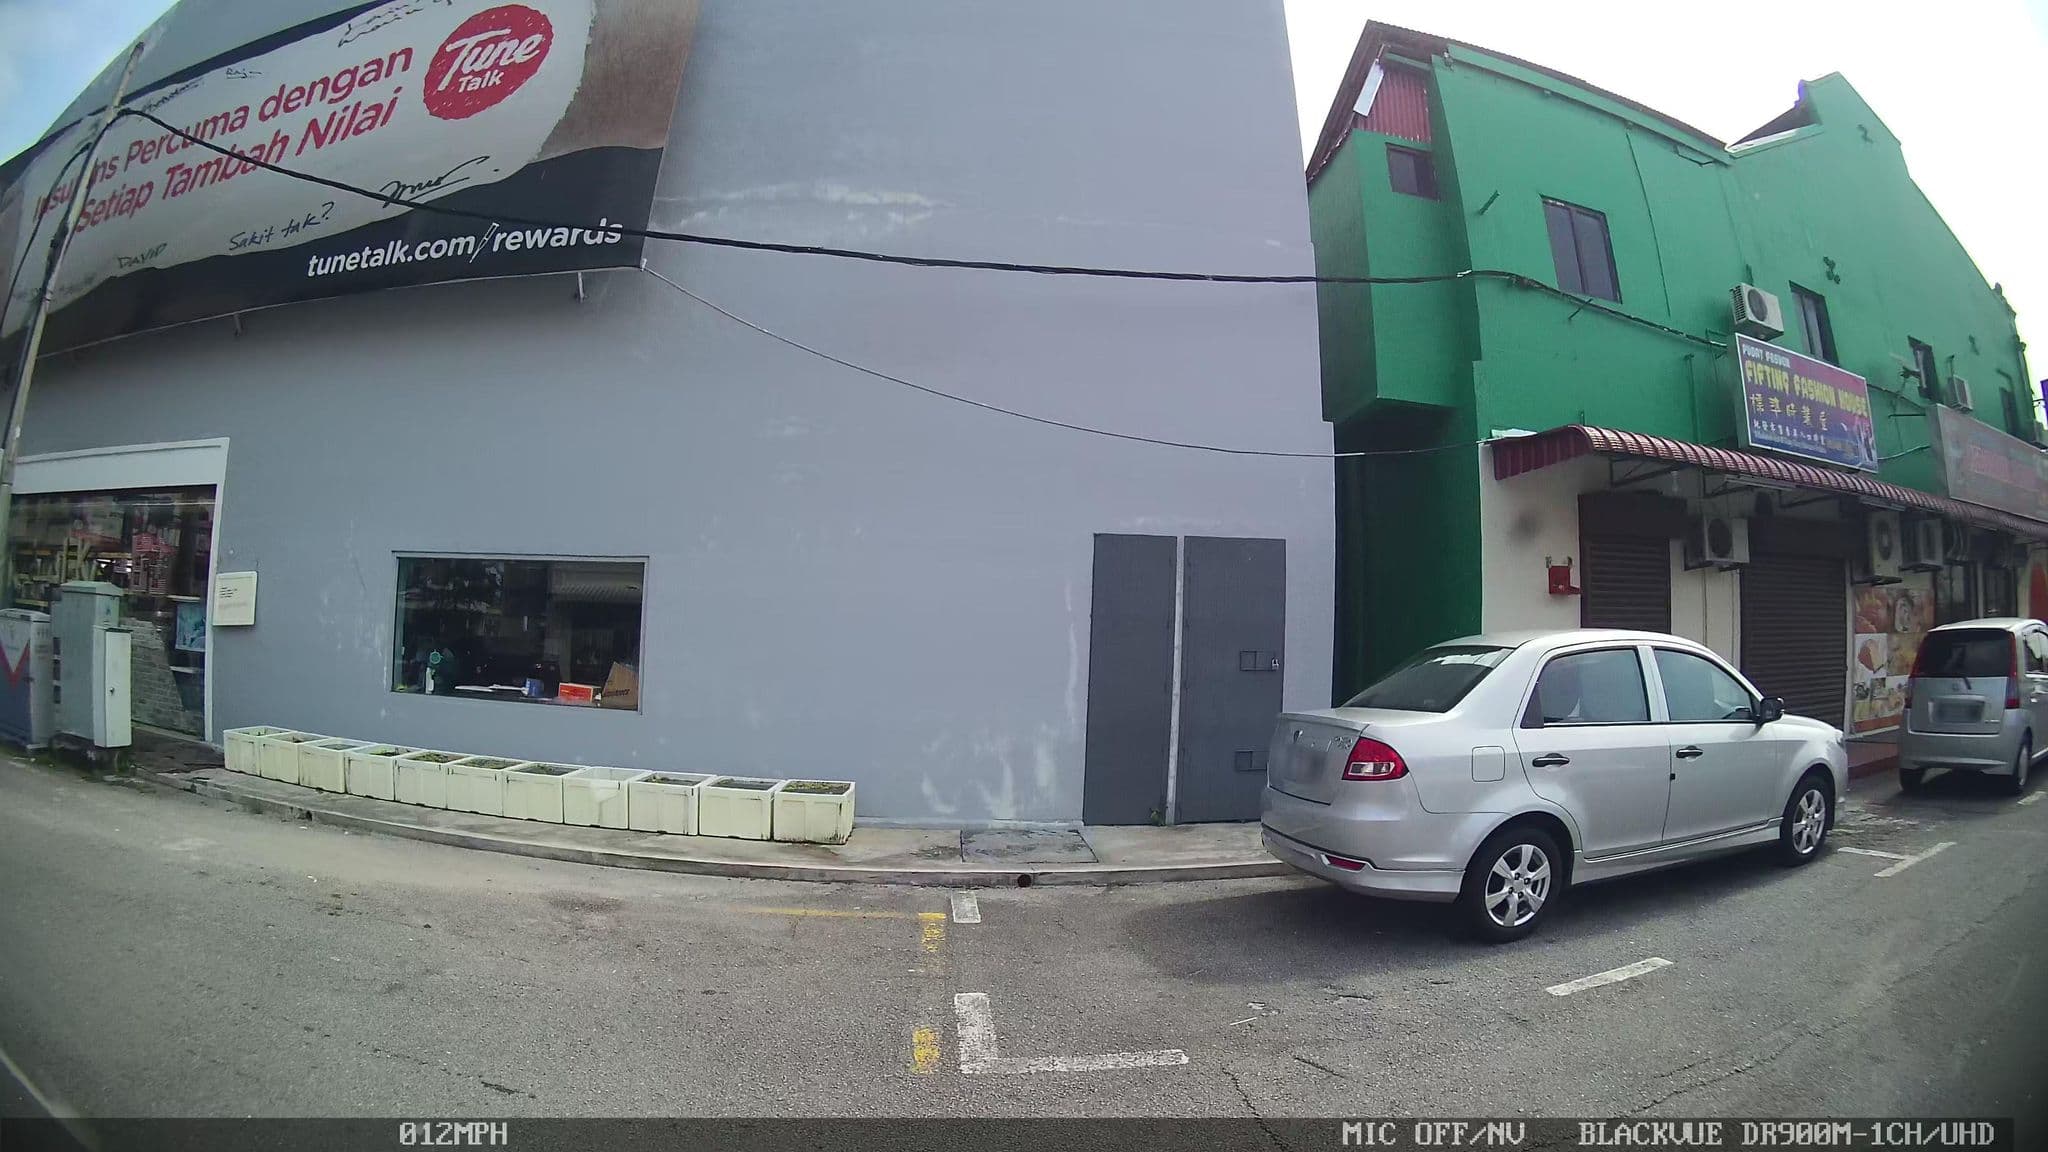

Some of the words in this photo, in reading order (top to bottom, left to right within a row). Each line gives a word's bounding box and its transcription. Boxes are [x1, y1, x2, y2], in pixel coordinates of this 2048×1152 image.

[438, 28, 544, 91] Tune
[458, 69, 504, 93] Talk
[125, 105, 250, 173] Percuma
[258, 47, 413, 122] dengan
[77, 182, 153, 232] Setiap
[164, 129, 290, 200] Tambah
[296, 86, 402, 157] Nilai
[229, 226, 275, 251] Sakit
[1793, 374, 1837, 407] FASHION
